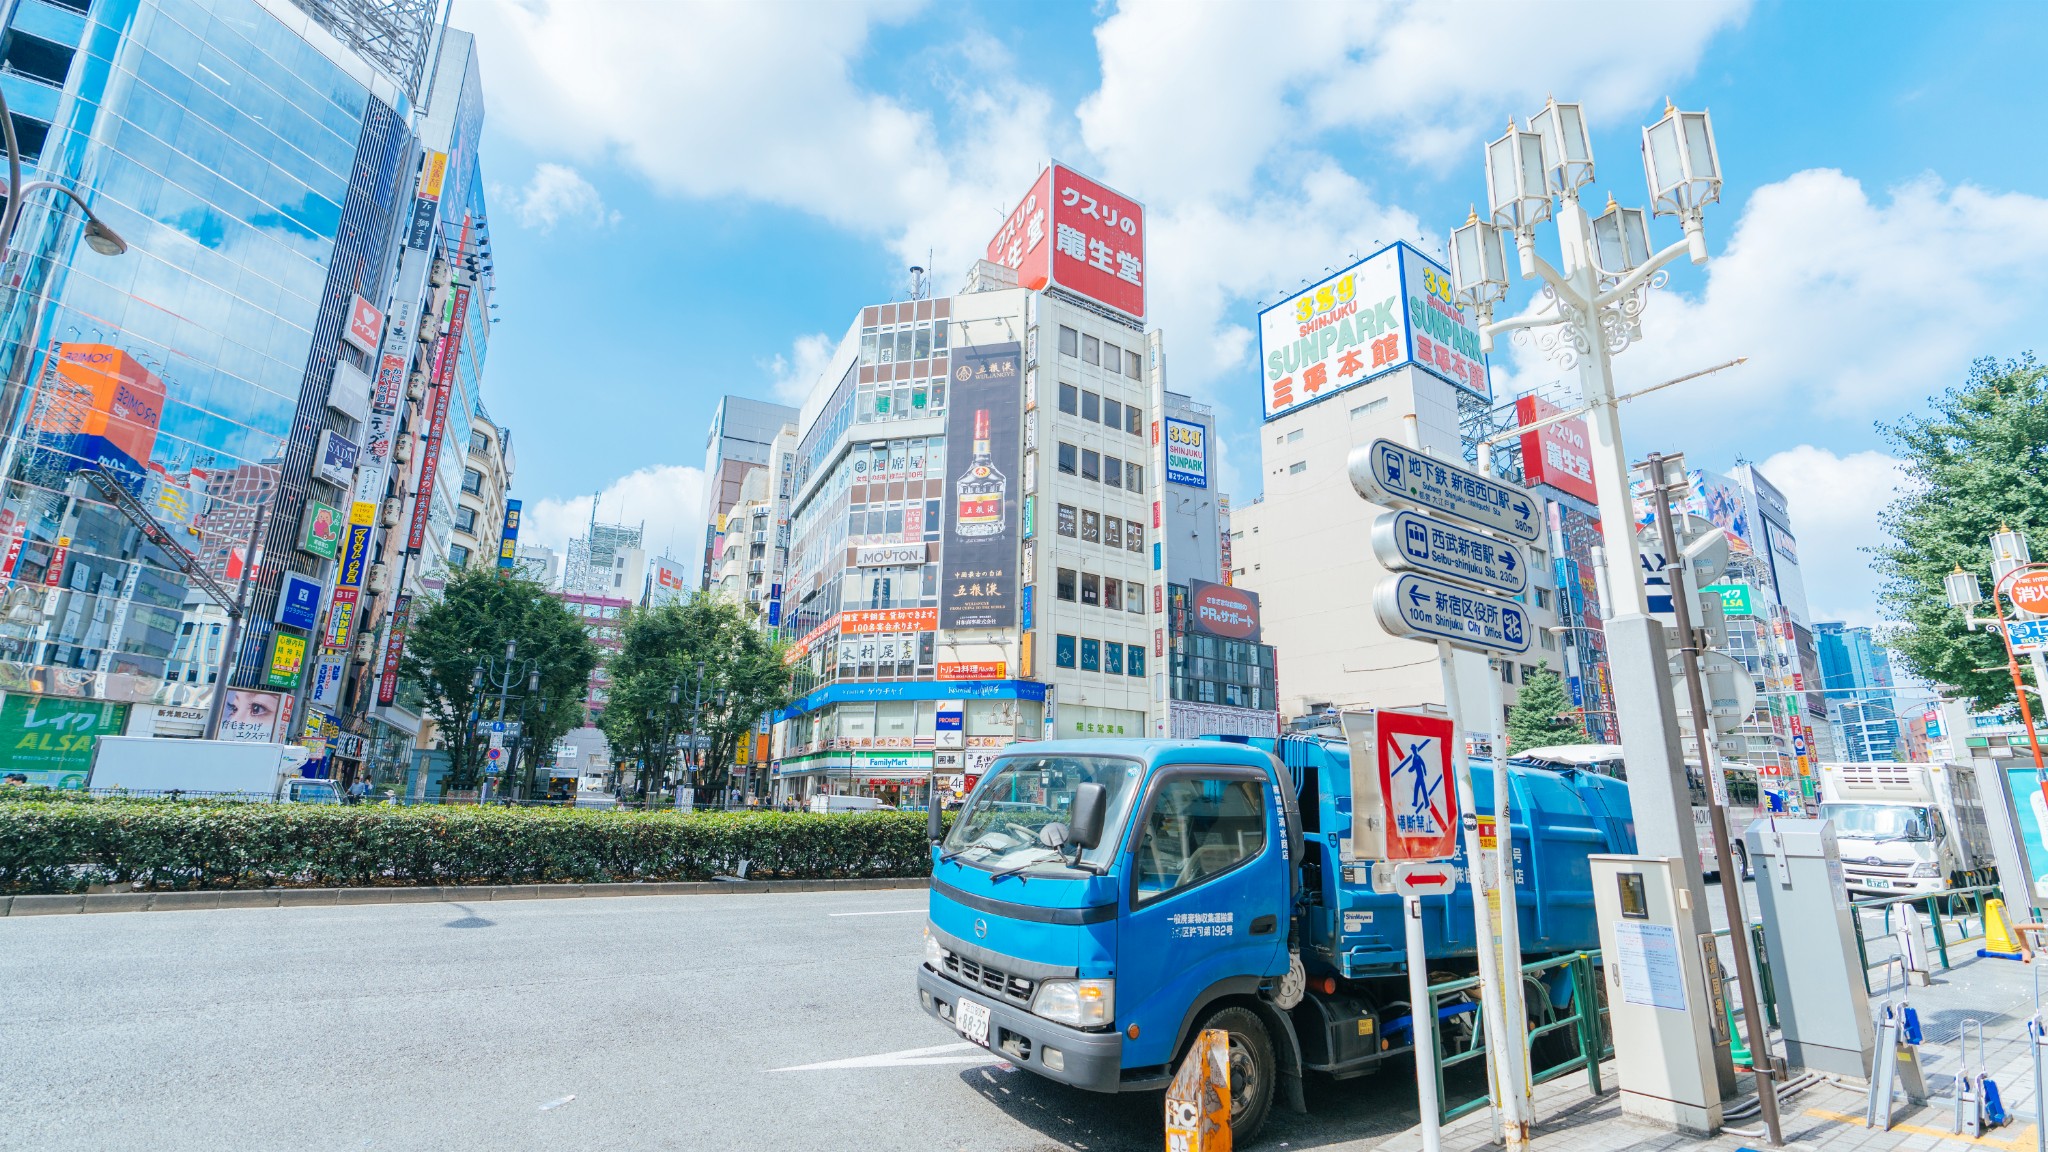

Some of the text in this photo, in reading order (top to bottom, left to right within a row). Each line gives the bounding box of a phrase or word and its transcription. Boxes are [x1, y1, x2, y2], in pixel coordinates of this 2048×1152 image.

[422, 201, 432, 210] 7F
[1061, 187, 1136, 236] クスリの
[997, 194, 1036, 254] クスリの
[997, 208, 1044, 269] 生堂
[1057, 222, 1142, 287] 龍生堂
[1296, 272, 1358, 324] 389
[1300, 300, 1358, 337] SHINJUKU
[1427, 294, 1465, 325] SHINJUKU
[354, 318, 376, 340] アイフル
[1268, 296, 1399, 380] SUNPARK
[1410, 296, 1484, 366] SUNPARK
[1272, 334, 1398, 409] 三平本館
[1417, 334, 1485, 392] 三平本館
[975, 372, 1016, 380] WULIANGYE
[1170, 426, 1202, 447] 389
[328, 442, 352, 463] SADA
[1170, 446, 1202, 458] SHINJUKU
[1546, 440, 1592, 484] 龍生堂
[873, 456, 923, 472] 相席屋
[1170, 454, 1203, 472] SUNPARK
[1408, 456, 1511, 512] 地下鉄 新宿西口駅
[1514, 519, 1534, 534] 380m
[864, 550, 918, 564] MOUTON
[1432, 528, 1496, 566] 西武新宿駅
[1432, 550, 1518, 586] Seibu-shinjuku Sta. 230m
[336, 590, 356, 598] B1F
[1721, 590, 1740, 598] イク
[2015, 584, 2048, 602] 消火
[890, 610, 936, 620] 貸切できます。
[1200, 606, 1254, 628] PRをサポート
[1436, 590, 1498, 626] 新宿区役所
[336, 603, 352, 645] まんが喫茶
[852, 622, 924, 632] 100名宴会承ります。
[1410, 608, 1502, 640] 100m Shinjuku City Office
[278, 647, 301, 656] 精神科
[280, 637, 304, 647] 心療内科
[276, 656, 290, 664] 内科
[940, 664, 978, 674] トルコ料理
[314, 664, 328, 700] SUNPARK
[332, 665, 340, 680] NEW
[24, 709, 97, 731] レイク
[158, 710, 204, 720] 新光第2ビル
[222, 720, 262, 731] 育毛まつげ
[16, 732, 92, 752] ALSA
[870, 758, 908, 768] FamilyMart
[950, 776, 964, 788] 4F
[1397, 814, 1434, 834] 横断禁止
[963, 1014, 987, 1038] 88-23
